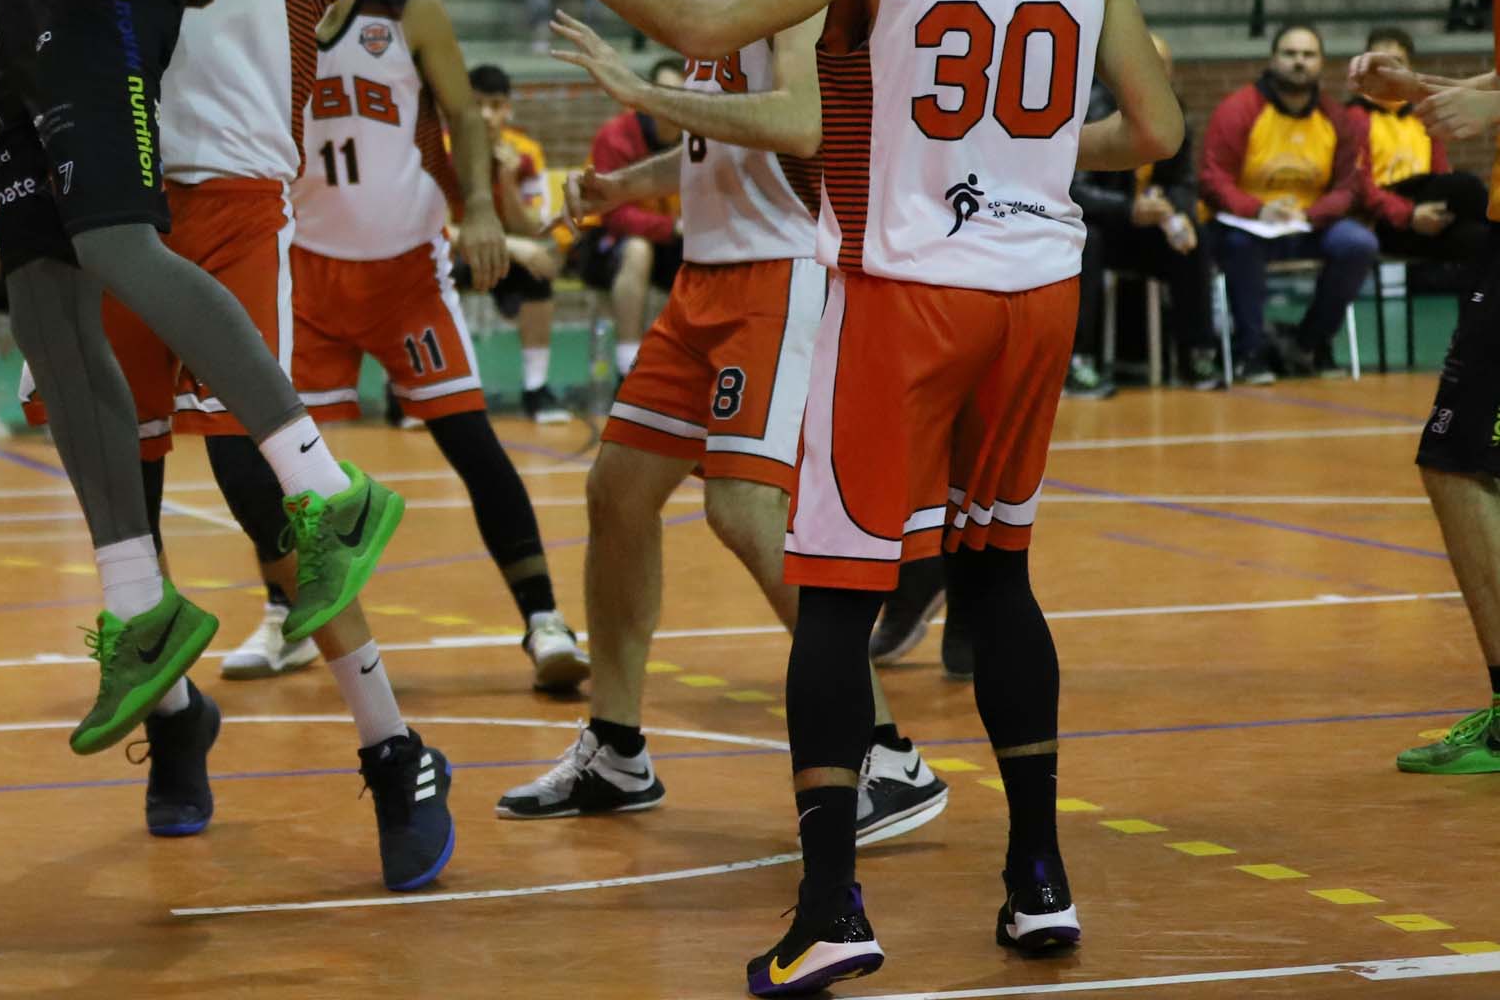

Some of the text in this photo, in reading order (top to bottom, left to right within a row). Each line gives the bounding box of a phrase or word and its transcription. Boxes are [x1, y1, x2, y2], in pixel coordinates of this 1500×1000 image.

[911, 0, 1081, 142] 30
[127, 75, 154, 188] nutrition
[57, 160, 74, 195] 7
[319, 137, 360, 187] 11
[403, 327, 448, 377] 11
[710, 365, 747, 420] 8
